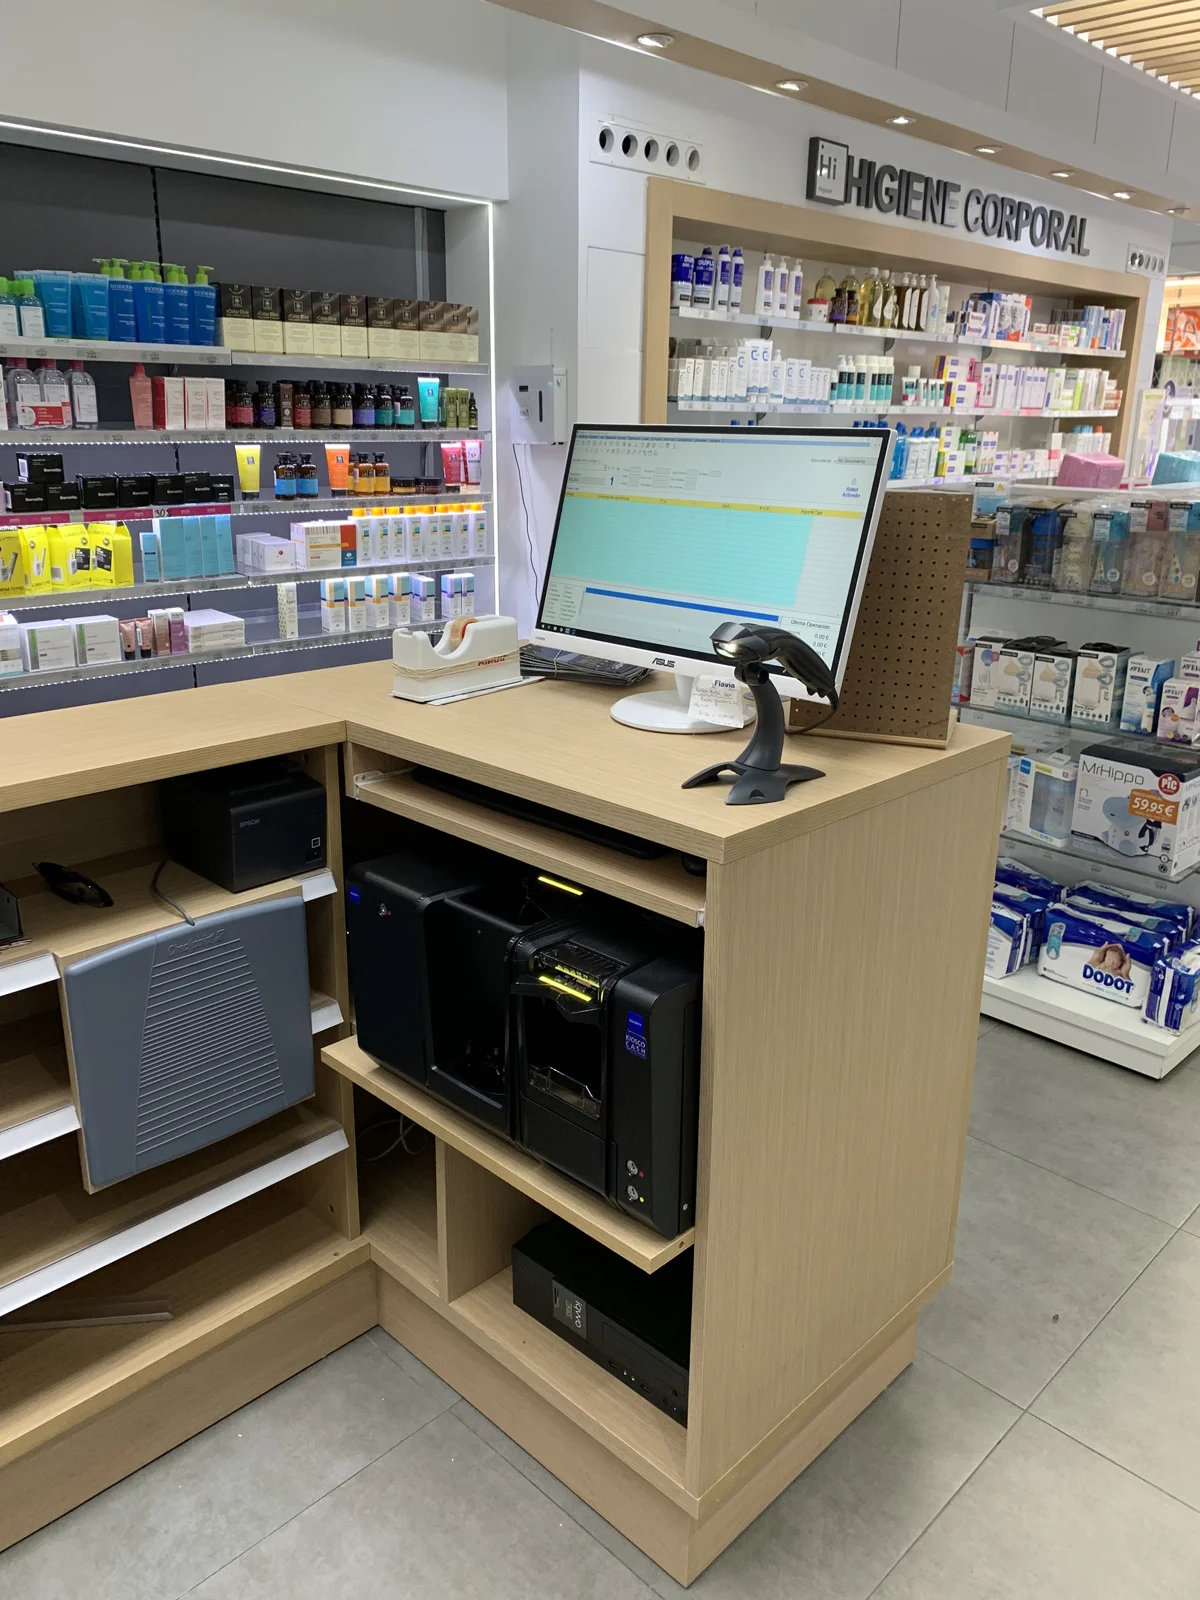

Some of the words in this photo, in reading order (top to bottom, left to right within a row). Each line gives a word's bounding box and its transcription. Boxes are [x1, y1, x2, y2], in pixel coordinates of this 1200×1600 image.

[819, 154, 837, 180] Hi
[847, 154, 961, 228] HIGIENE
[963, 188, 1091, 257] CORPORAL
[806, 621, 831, 630] Operación
[652, 656, 676, 669] ASUS
[714, 679, 736, 689] Flavia
[1081, 760, 1145, 786] MrHippo
[1131, 797, 1164, 814] 59,95
[1164, 805, 1176, 817] €
[240, 819, 260, 828] EPSON
[1082, 963, 1135, 994] DODOT
[625, 1033, 646, 1048] KIOSCO
